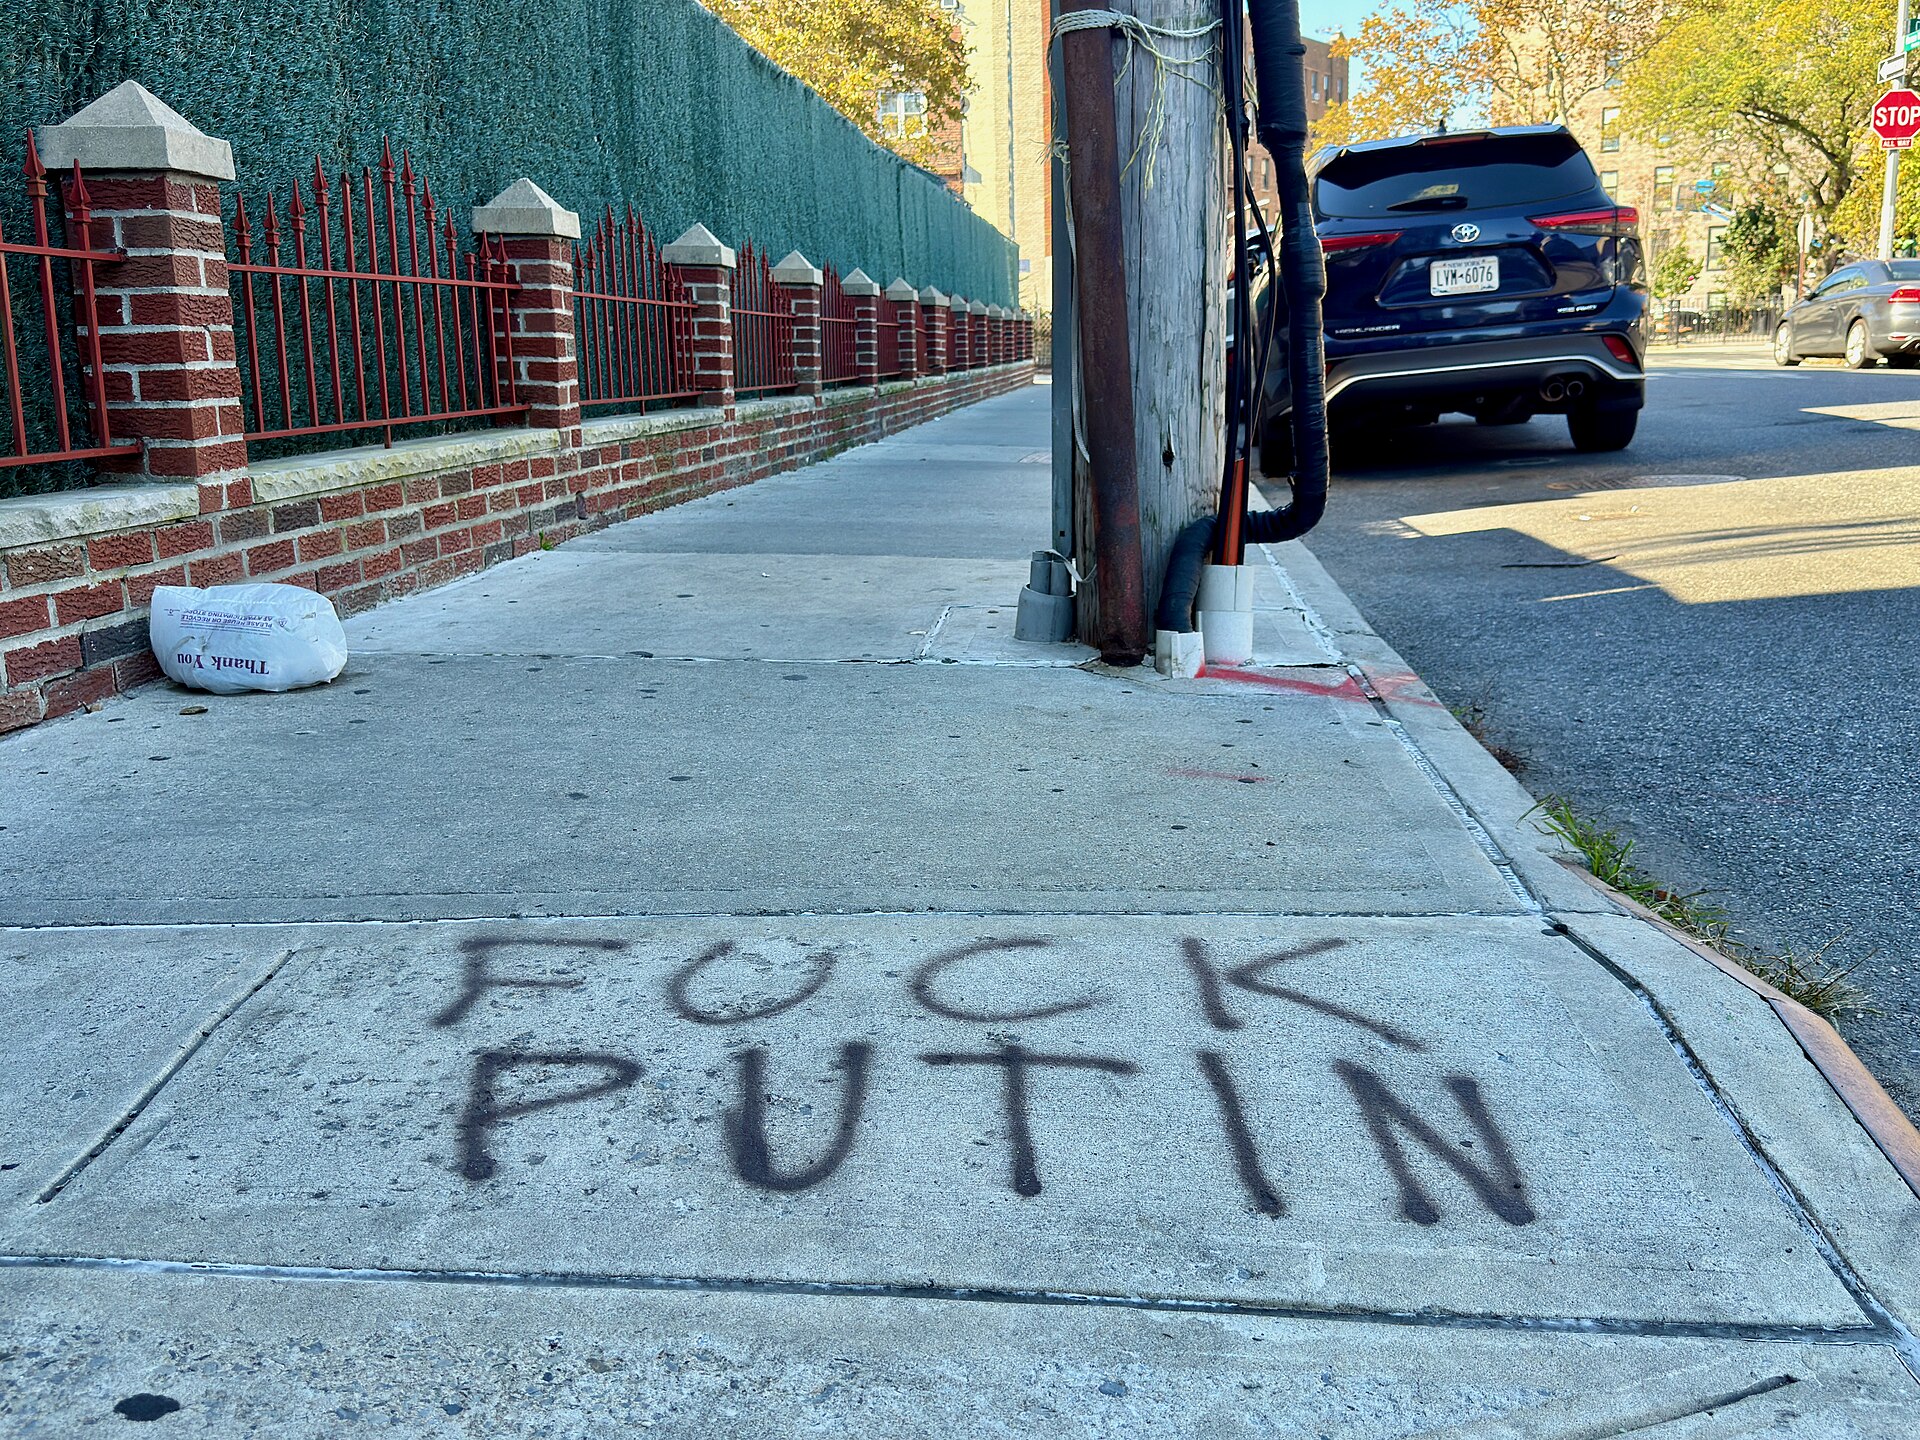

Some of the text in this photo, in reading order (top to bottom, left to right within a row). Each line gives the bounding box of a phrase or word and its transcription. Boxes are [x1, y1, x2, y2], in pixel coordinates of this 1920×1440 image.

[1875, 105, 1920, 127] STOP
[1465, 266, 1493, 284] 6076
[180, 614, 211, 622] RECYCLE
[223, 619, 246, 627] REUSE
[247, 621, 273, 629] PLEASE
[177, 653, 269, 675] Thank You
[433, 936, 1426, 1052] FUCK
[456, 1040, 1534, 1226] PUTIN
